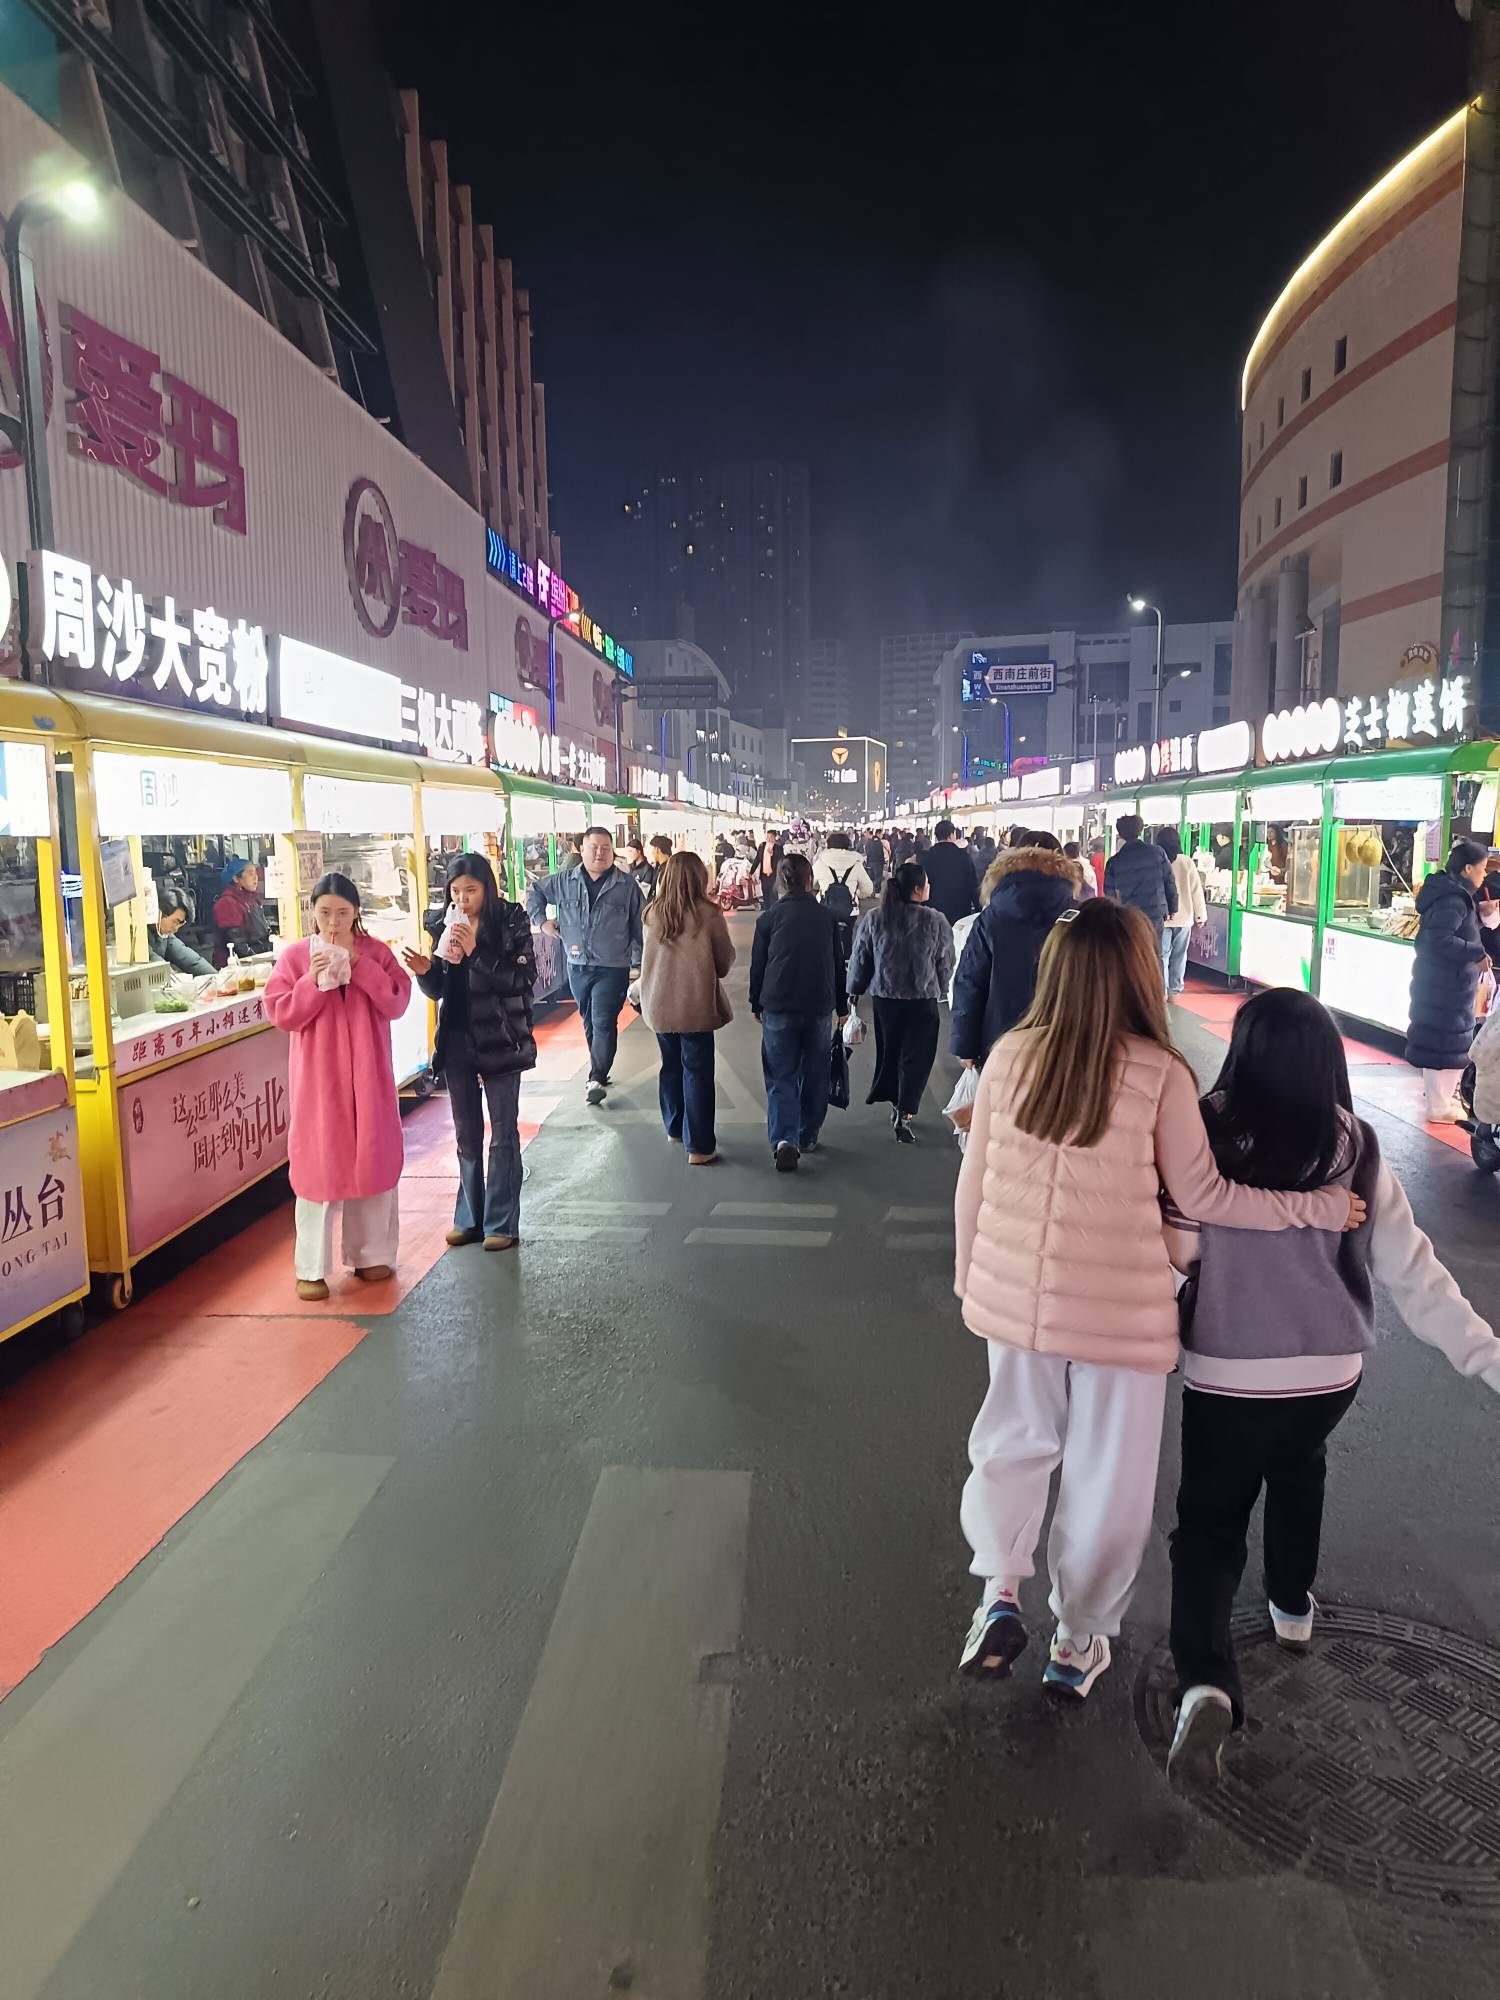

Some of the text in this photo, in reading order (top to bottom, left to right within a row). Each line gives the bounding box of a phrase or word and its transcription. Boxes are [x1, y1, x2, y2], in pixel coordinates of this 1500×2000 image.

[60, 302, 247, 535] 爱玛
[41, 549, 269, 713] 周沙大宽粉
[992, 667, 1051, 680] 西南庄前街
[173, 1072, 246, 1138] 这么近那么美
[193, 1077, 287, 1171] 周末到河北
[1, 1173, 66, 1244] 丛台
[2, 1231, 70, 1277] ONG TAI
